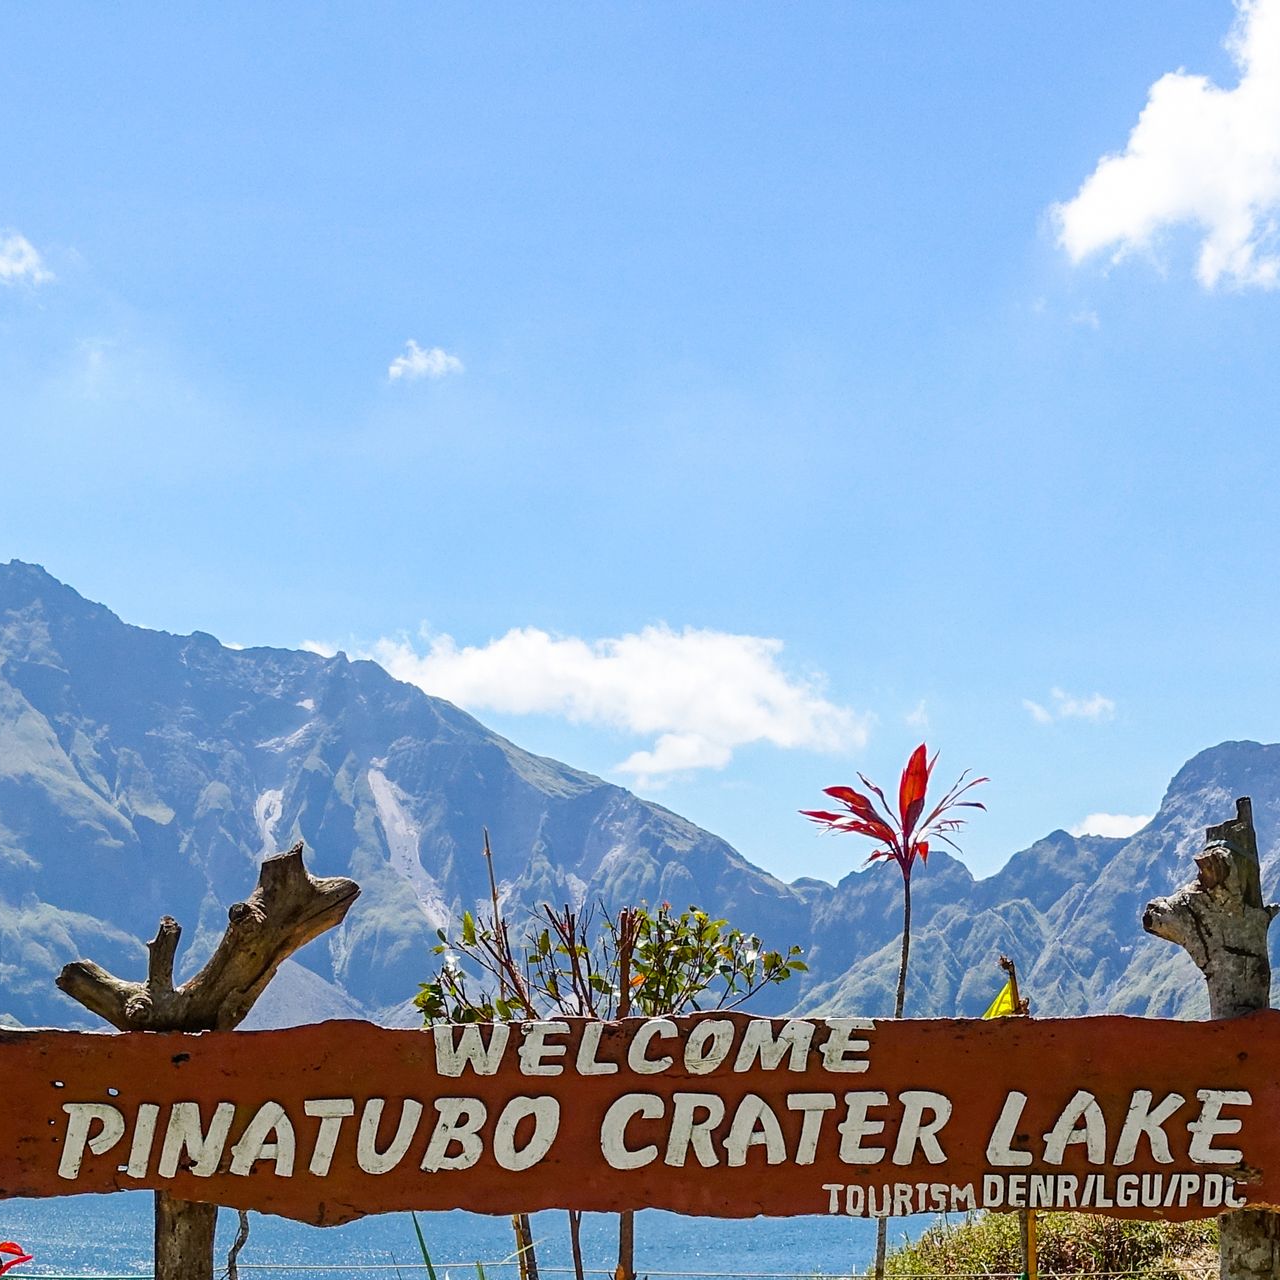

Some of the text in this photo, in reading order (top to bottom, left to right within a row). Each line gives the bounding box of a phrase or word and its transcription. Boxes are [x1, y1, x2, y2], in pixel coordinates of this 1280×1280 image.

[433, 1019, 875, 1077] WELCOME
[58, 1089, 1253, 1180] PINATUBO CRATER LAKE
[822, 1182, 977, 1217] TOURISM
